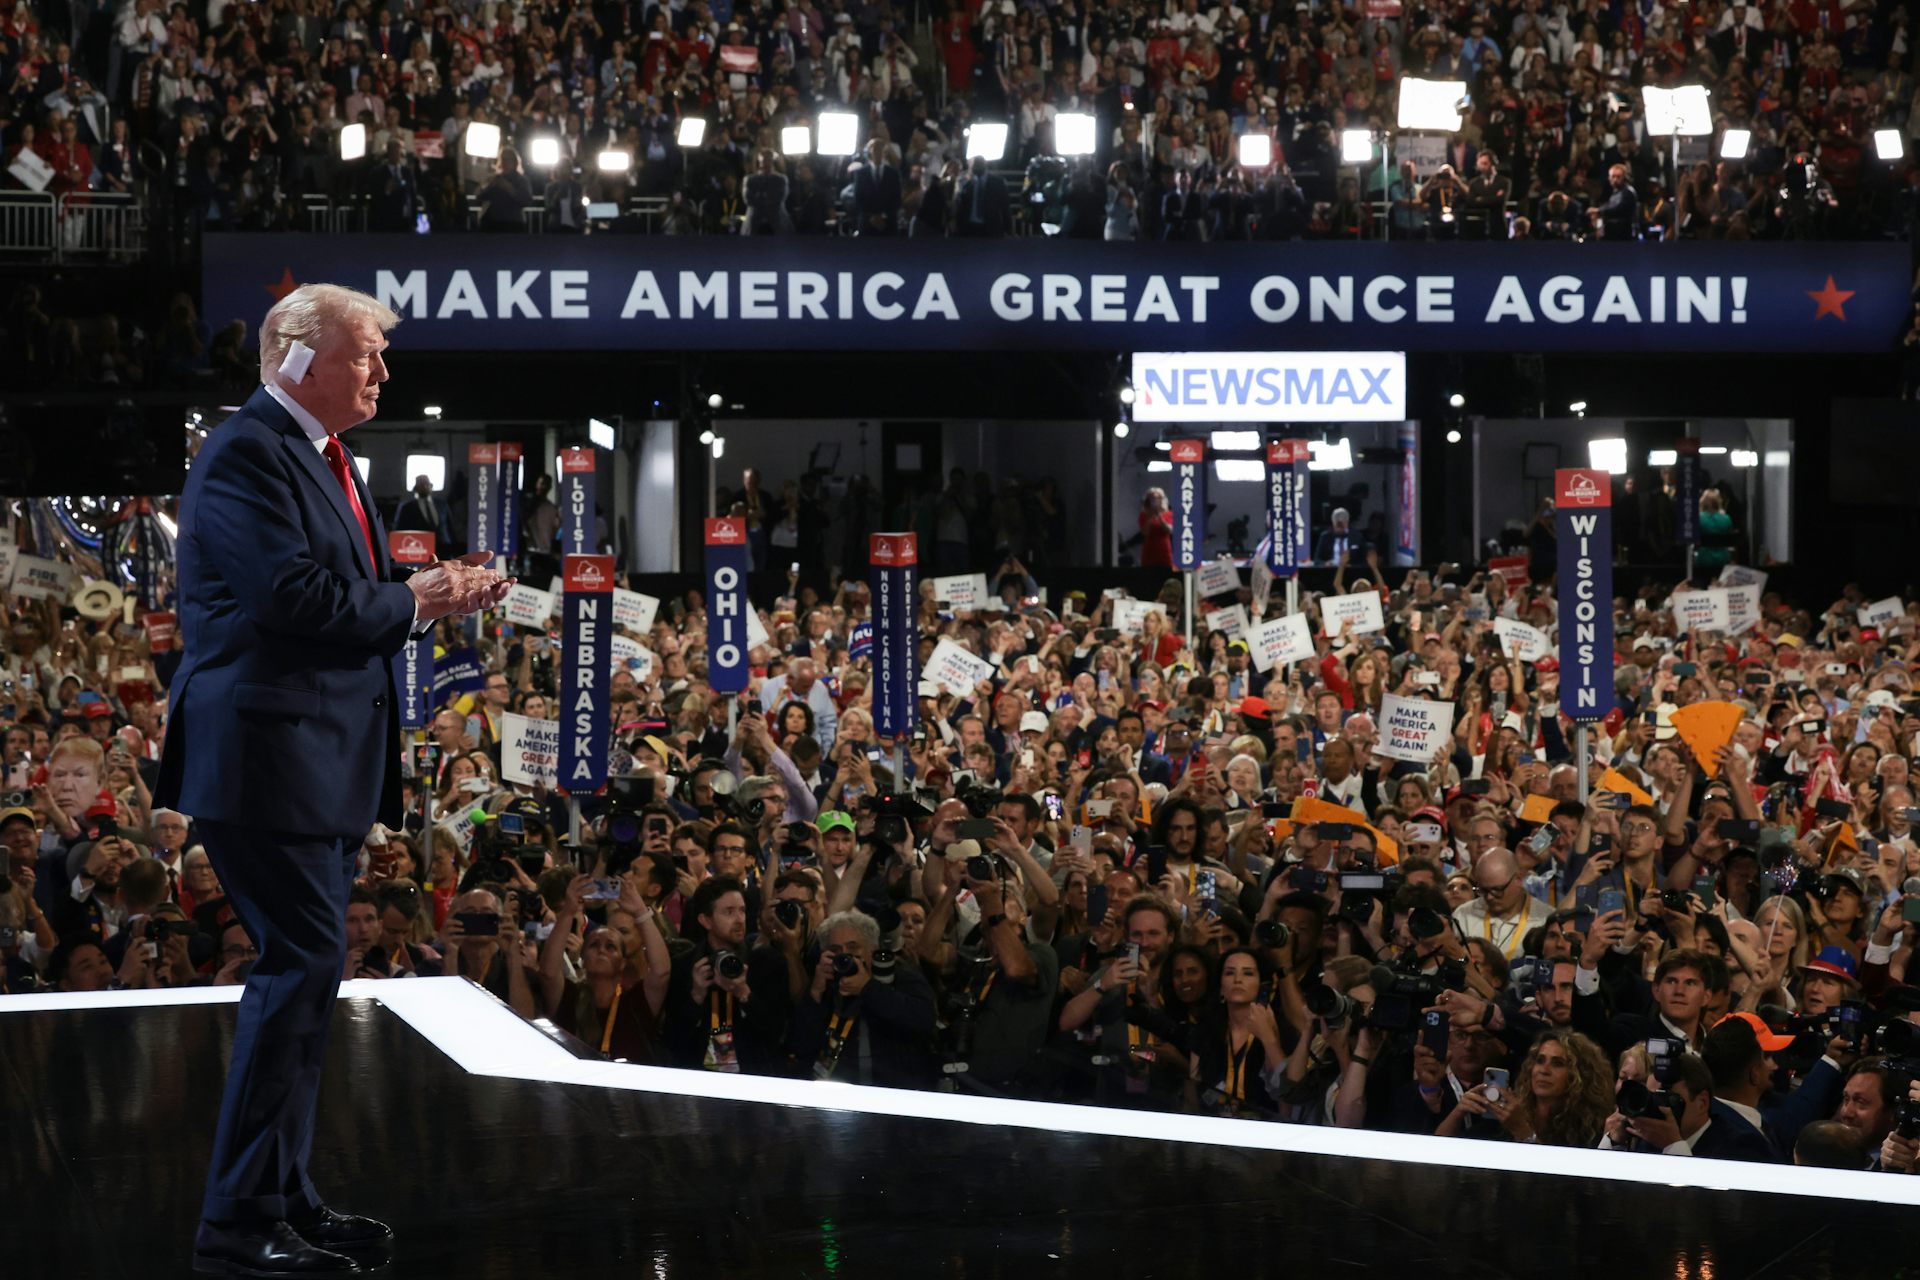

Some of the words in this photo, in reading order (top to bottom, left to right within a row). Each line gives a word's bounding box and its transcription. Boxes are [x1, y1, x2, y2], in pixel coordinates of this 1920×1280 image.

[375, 269, 590, 318] MAKE
[620, 270, 960, 320] AMERICA
[989, 272, 1220, 323] GREAT
[1250, 275, 1455, 323] ONCE
[1485, 275, 1748, 323] AGAIN!
[1145, 367, 1393, 406] NEWSMAX
[571, 477, 585, 554] LOUISI
[1180, 464, 1195, 565] MARYLAND
[1271, 472, 1285, 566] NORTHERN
[714, 566, 741, 668] OHIO
[880, 570, 889, 629] NORTH
[904, 570, 912, 628] NORTH
[1570, 514, 1598, 708] WISCONSIN
[1263, 625, 1287, 637] MAKE
[405, 640, 418, 720] HUSETTS
[572, 599, 599, 780] NEBRASKA
[881, 635, 892, 729] CAROLINA
[905, 634, 914, 728] CAROLINA
[525, 728, 560, 743] MAKE
[1388, 716, 1436, 731] AMERICA
[1391, 727, 1428, 741] GREAT
[1396, 706, 1428, 720] MAKE
[515, 738, 560, 754] AMERIC
[521, 751, 553, 765] GREA
[1389, 738, 1428, 751] AGAIN!
